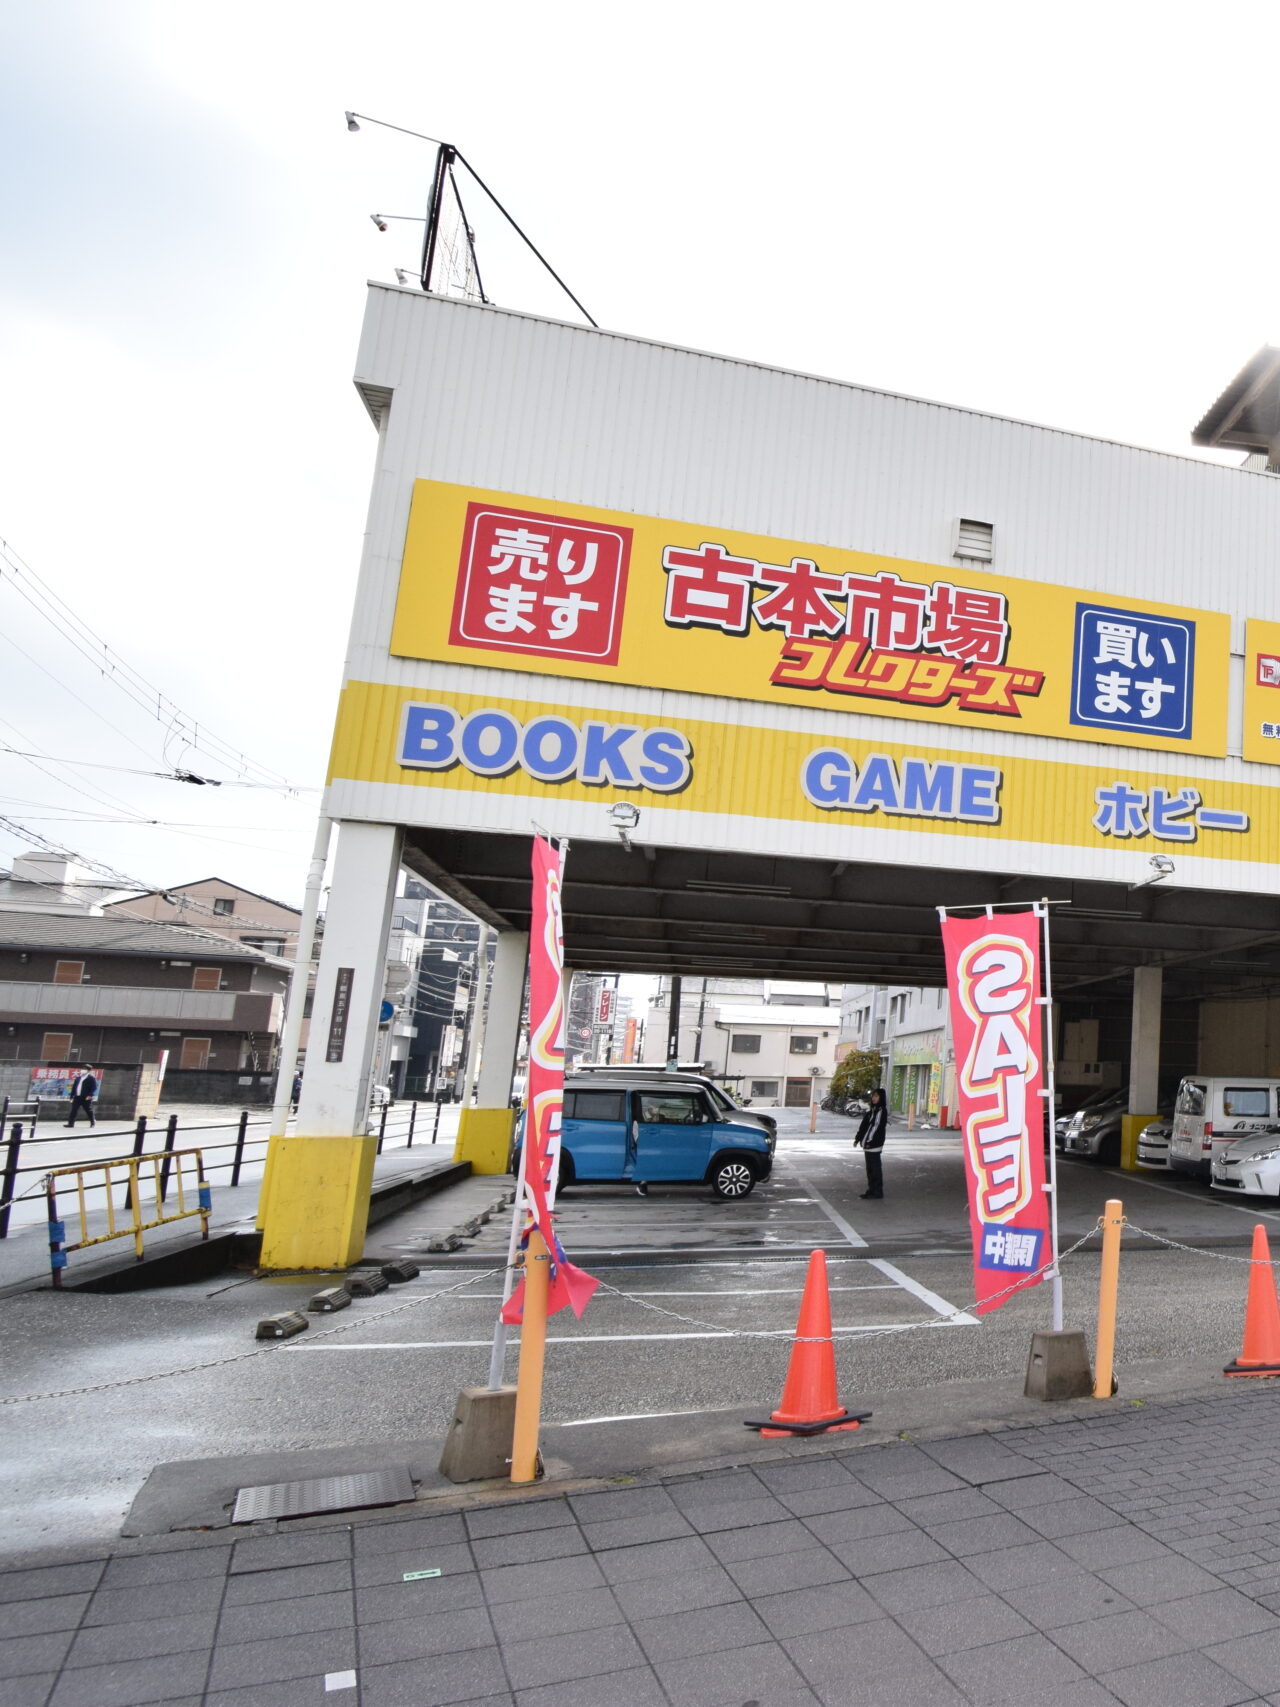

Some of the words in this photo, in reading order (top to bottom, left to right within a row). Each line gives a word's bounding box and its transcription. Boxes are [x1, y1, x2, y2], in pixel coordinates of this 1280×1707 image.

[487, 526, 599, 577] 売り
[486, 586, 599, 640] ます
[663, 543, 1010, 665] 古本市場
[1094, 620, 1176, 669] 買い
[773, 638, 1042, 713] コレクターズ
[1094, 670, 1175, 719] ます
[398, 703, 692, 790] BOOKS
[804, 749, 1000, 820] GAME
[1093, 785, 1247, 841] ホビー
